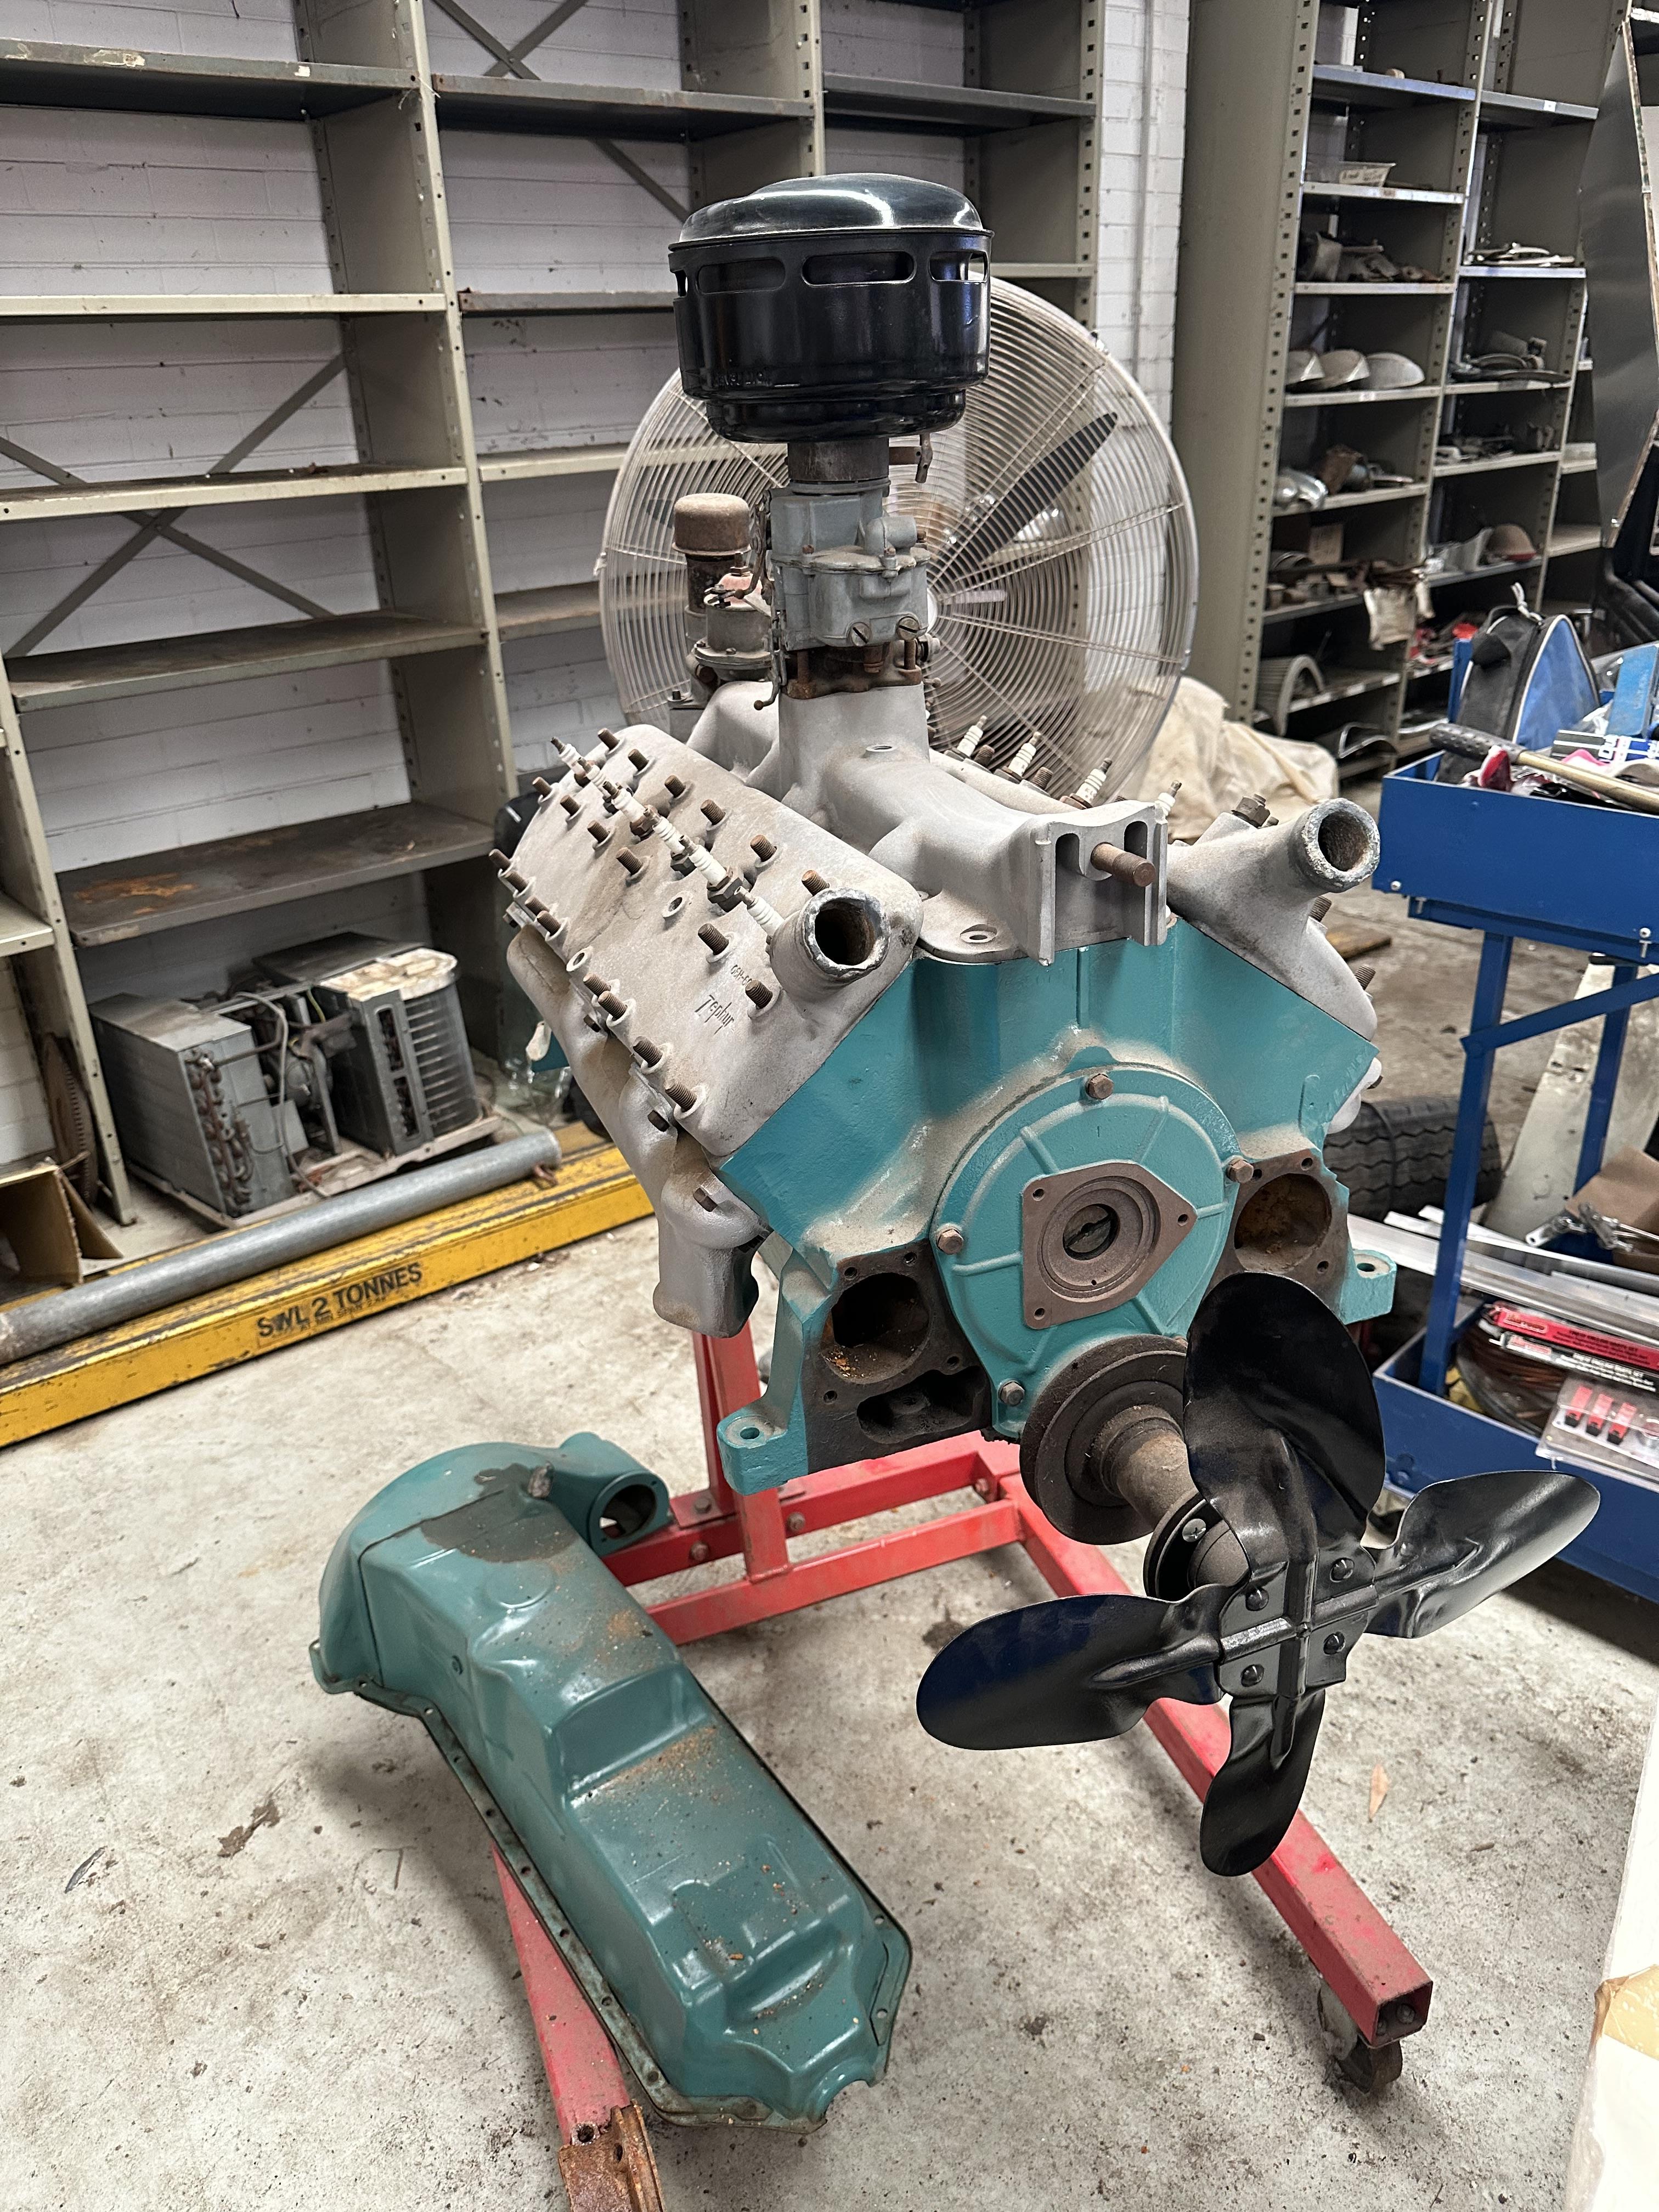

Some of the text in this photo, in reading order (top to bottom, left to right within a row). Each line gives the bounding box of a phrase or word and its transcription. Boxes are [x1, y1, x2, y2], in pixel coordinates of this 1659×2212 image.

[257, 1262, 422, 1337] SWL 2 TONNES
